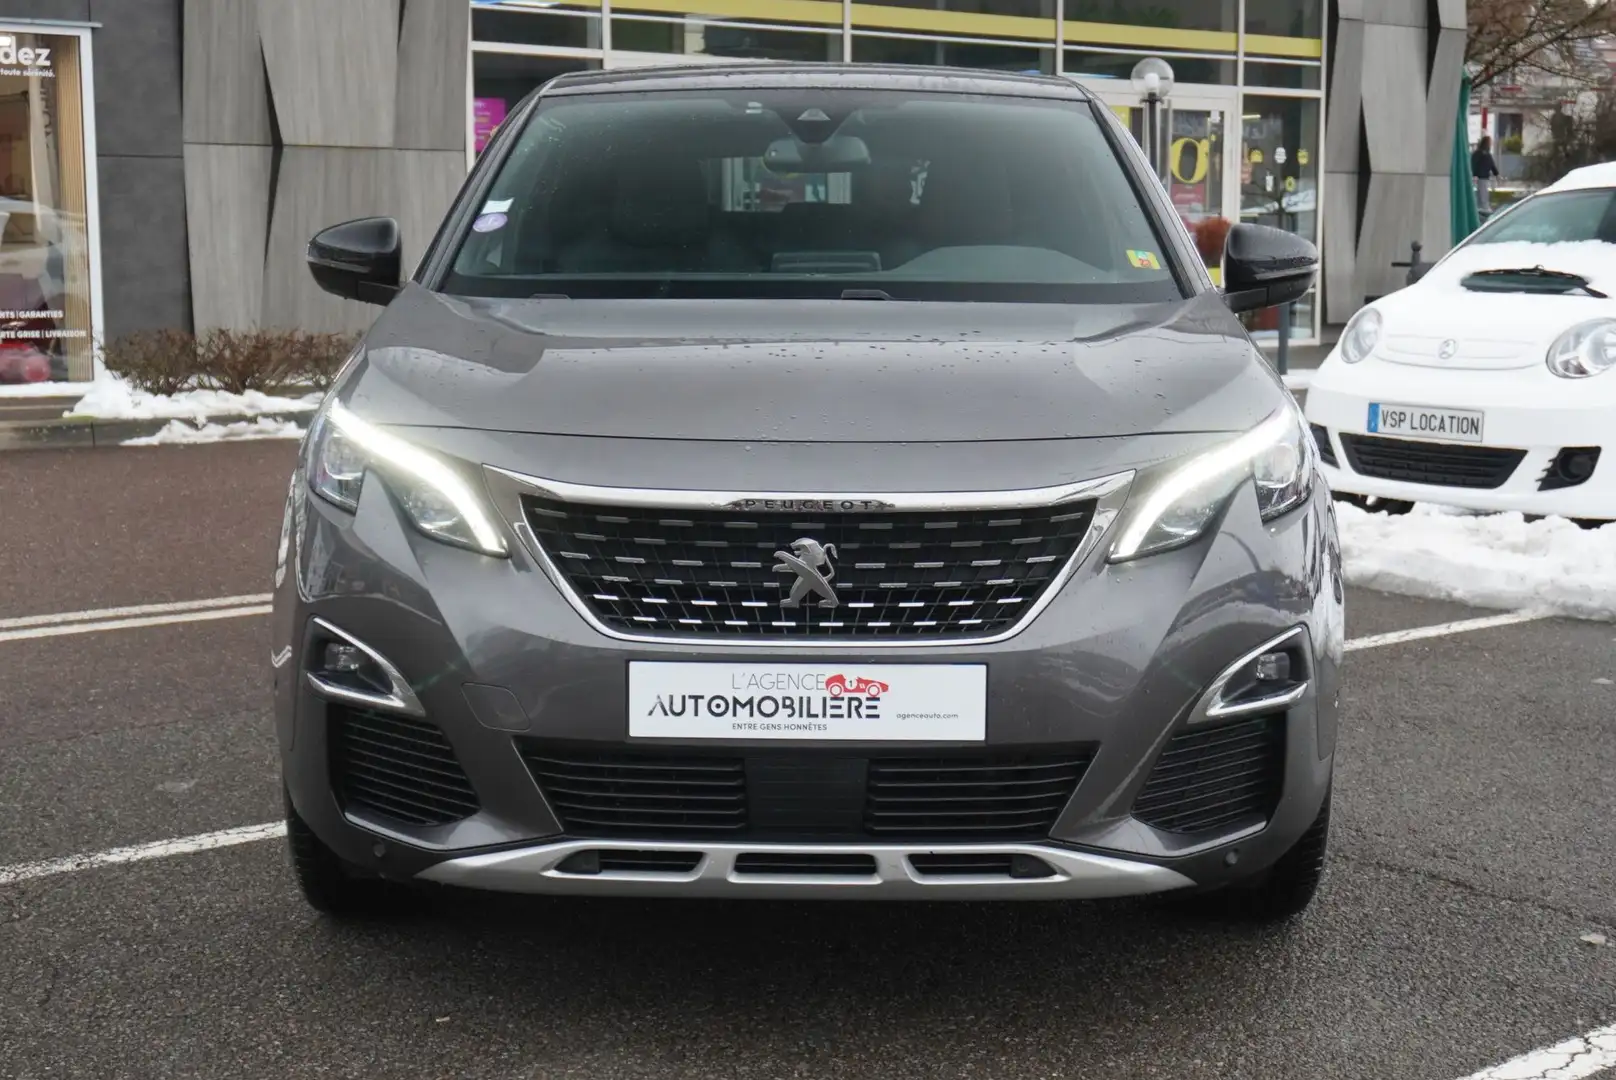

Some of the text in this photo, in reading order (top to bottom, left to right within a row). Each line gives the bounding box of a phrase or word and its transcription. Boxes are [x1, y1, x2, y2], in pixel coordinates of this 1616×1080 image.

[19, 310, 63, 319] GARANTIES
[16, 330, 41, 339] GRISE
[45, 329, 87, 338] LIVRAISON
[1381, 409, 1480, 435] VSP LOCATION
[745, 499, 872, 509] PEUGEOT
[731, 672, 826, 691] L'AGENCE
[896, 712, 959, 721] agenceauto.com
[732, 721, 827, 732] ENTRE GENS HONNÊTES
